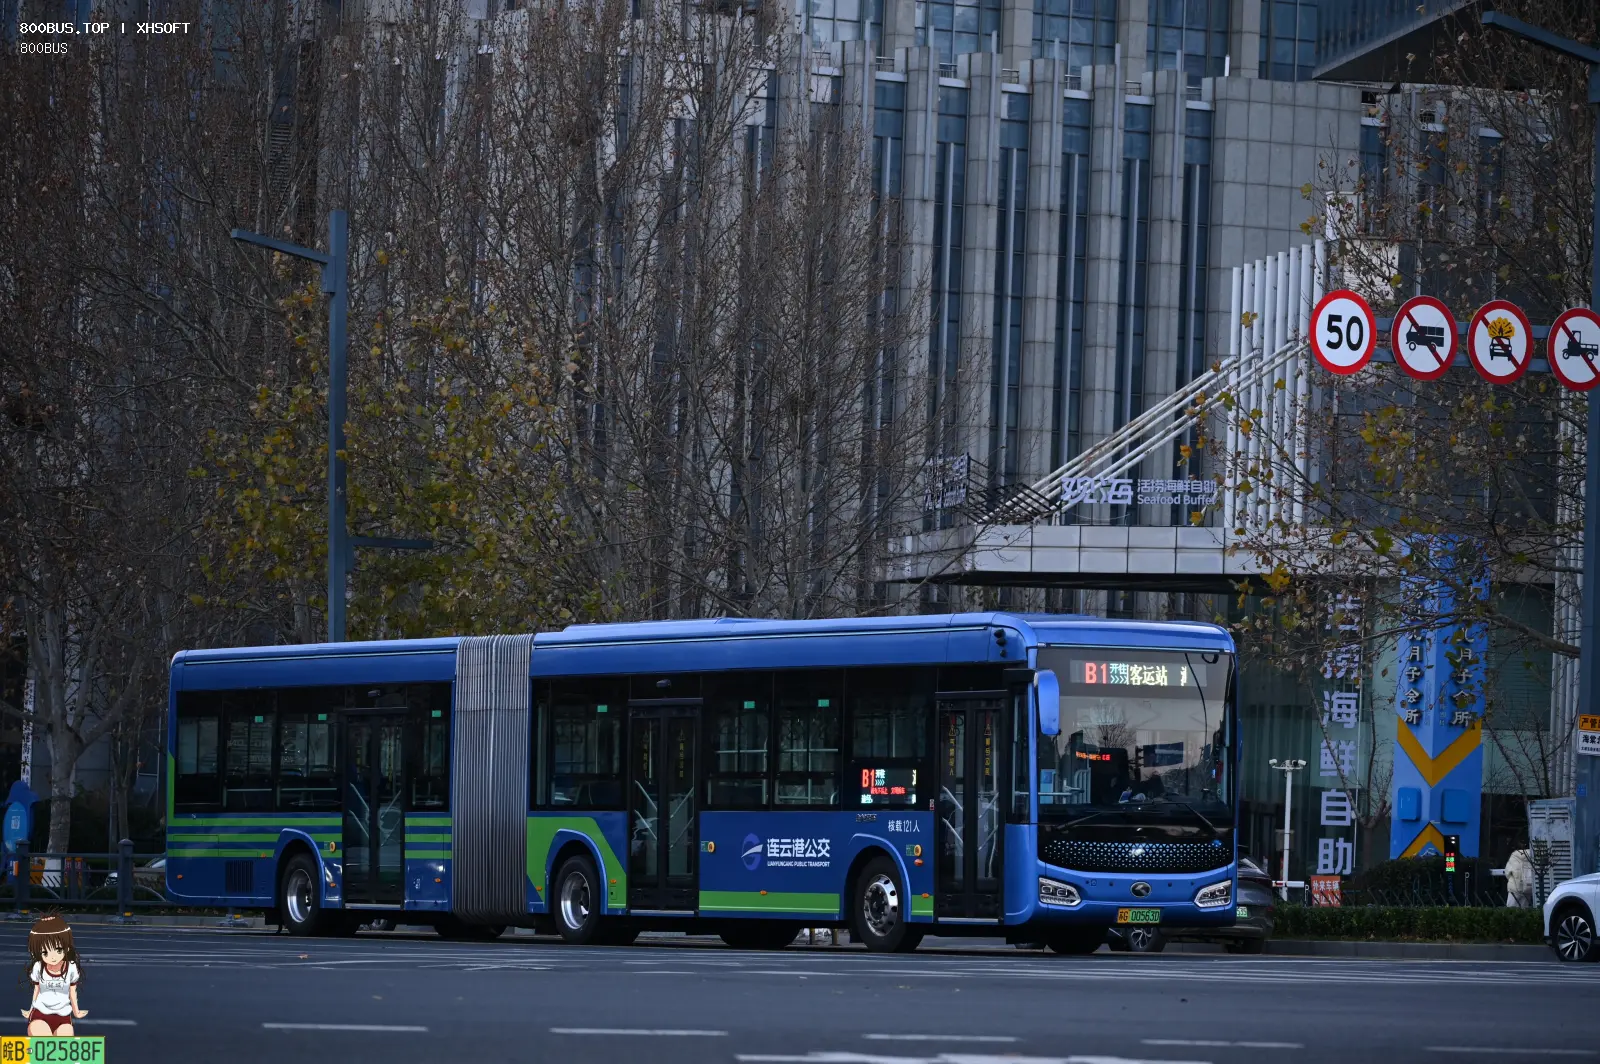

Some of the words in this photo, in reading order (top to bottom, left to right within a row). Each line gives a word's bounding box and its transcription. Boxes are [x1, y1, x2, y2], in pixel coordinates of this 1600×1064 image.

[1326, 314, 1364, 351] 50
[1060, 476, 1133, 505] 观海
[1136, 479, 1216, 494] 活捞海鲜自助
[1136, 494, 1181, 505] Seafood
[1085, 662, 1108, 685] B1
[1127, 664, 1169, 687] 客运站
[1581, 717, 1600, 728] 严管
[862, 769, 875, 788] B1
[888, 819, 920, 833] 核载121人
[767, 838, 830, 858] 连云港公交
[1312, 880, 1340, 892] 外来车辆
